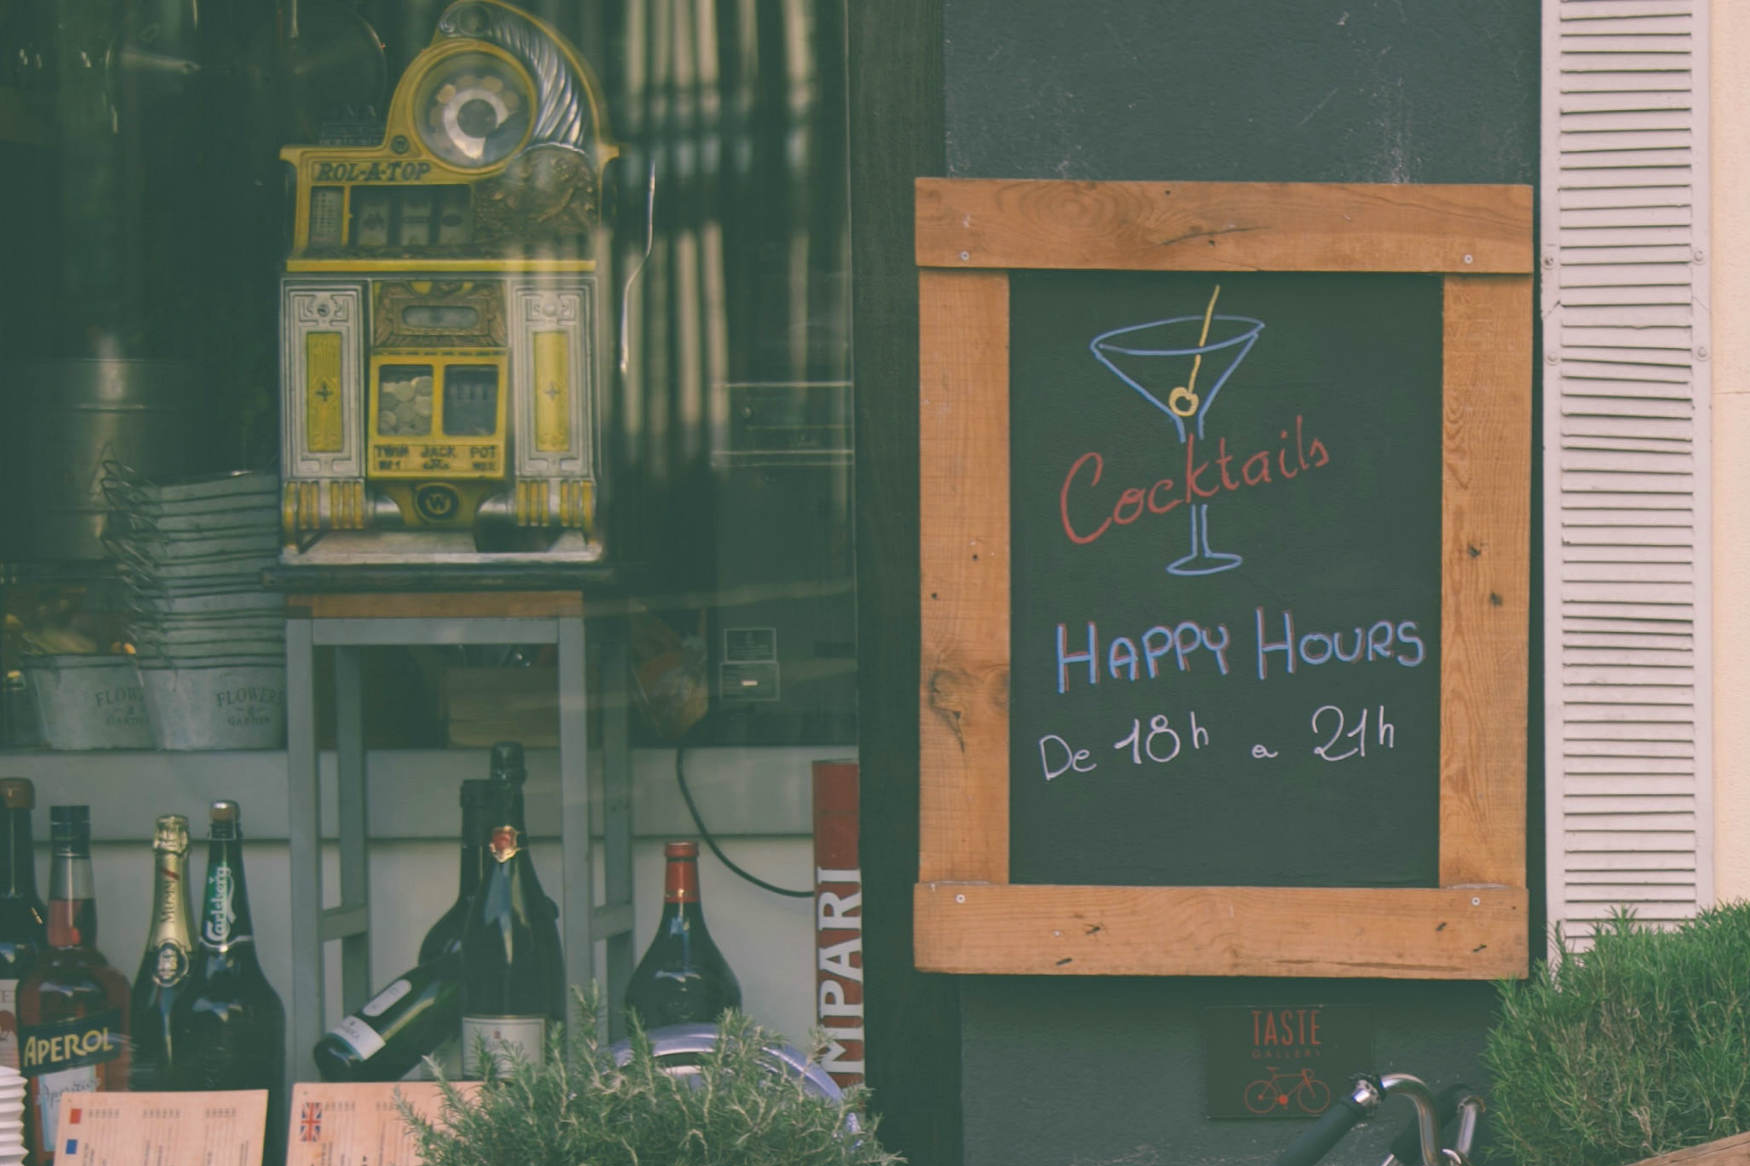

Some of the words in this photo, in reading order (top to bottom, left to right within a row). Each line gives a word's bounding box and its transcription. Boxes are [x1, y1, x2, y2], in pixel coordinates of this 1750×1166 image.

[317, 161, 431, 182] ROL-A-TOP
[470, 445, 497, 459] POT
[1060, 415, 1330, 544] Cocktails
[1056, 620, 1230, 694] HAPPY
[1256, 605, 1427, 680] HOURS
[1039, 735, 1097, 781] De
[1114, 711, 1209, 765] 18h
[1251, 743, 1278, 759] a
[1311, 705, 1395, 762] 21h
[206, 866, 236, 941] Carlsberg
[817, 866, 864, 1074] MPARI
[24, 1027, 114, 1067] APEROL
[1252, 1010, 1321, 1046] TASTE
